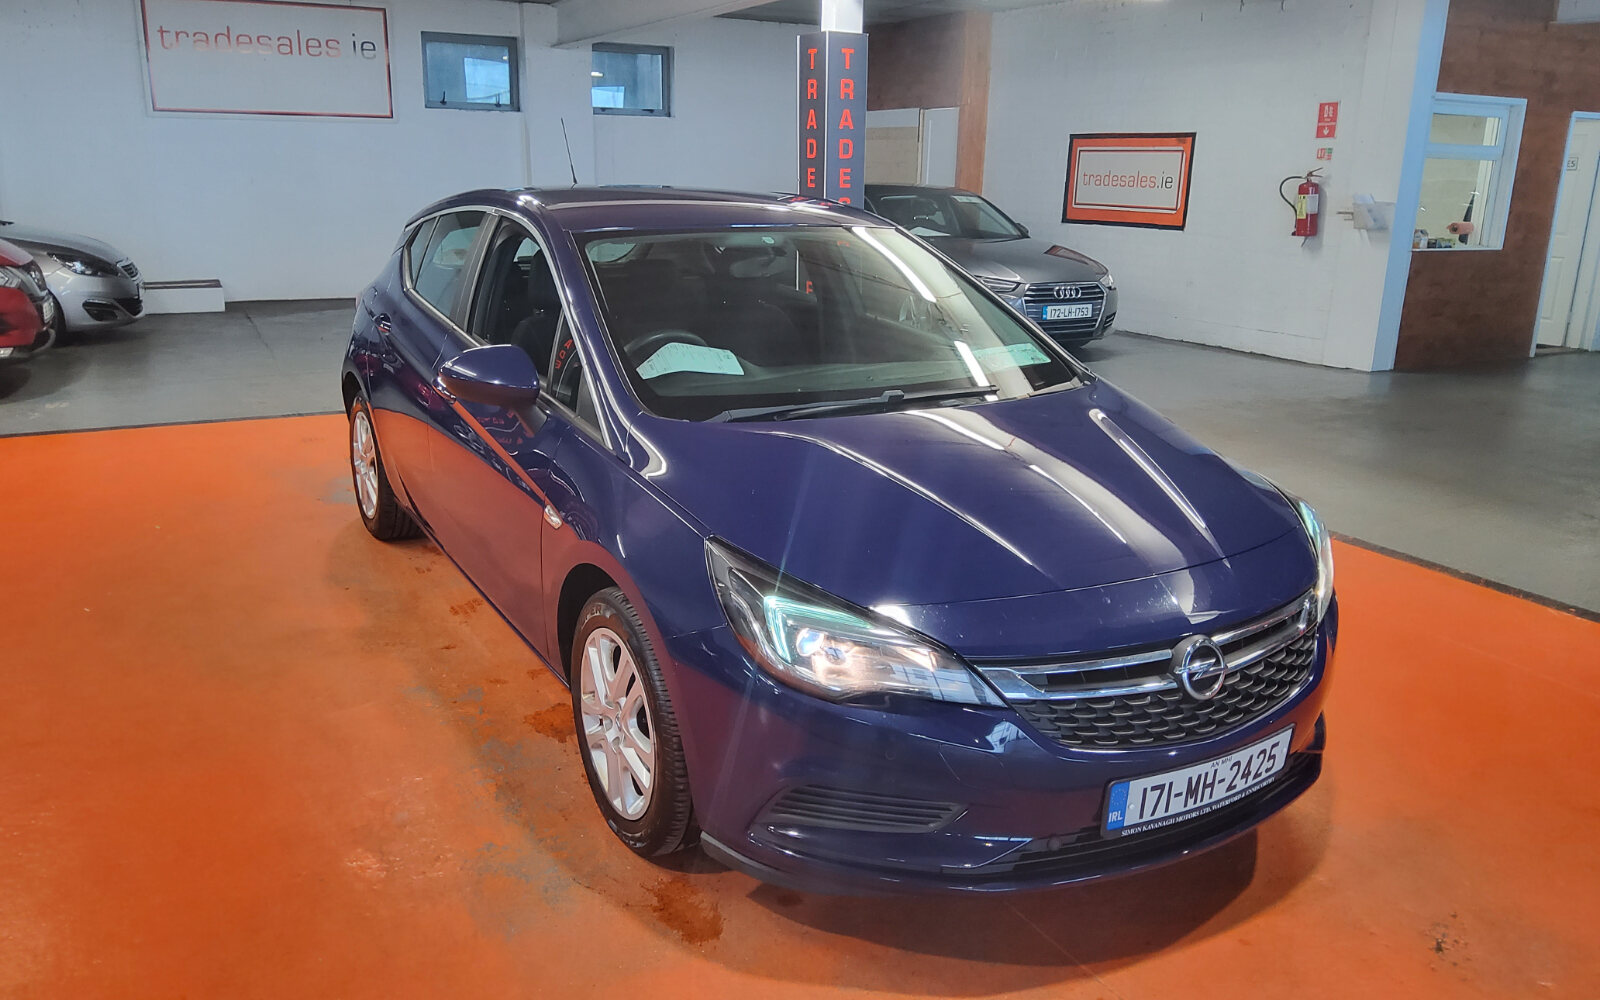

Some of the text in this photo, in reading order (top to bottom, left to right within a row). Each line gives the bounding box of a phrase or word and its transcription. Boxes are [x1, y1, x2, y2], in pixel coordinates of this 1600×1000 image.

[806, 48, 818, 188] TRADE
[1082, 169, 1174, 190] tradesales.ie
[1049, 307, 1089, 319] 172-LH-1753
[1138, 740, 1281, 820] 171-MH-2425
[1107, 810, 1124, 823] IRL
[1120, 826, 1142, 837] SIMON
[1142, 818, 1175, 832] KAVANAGH
[1175, 810, 1199, 823] MOTORS
